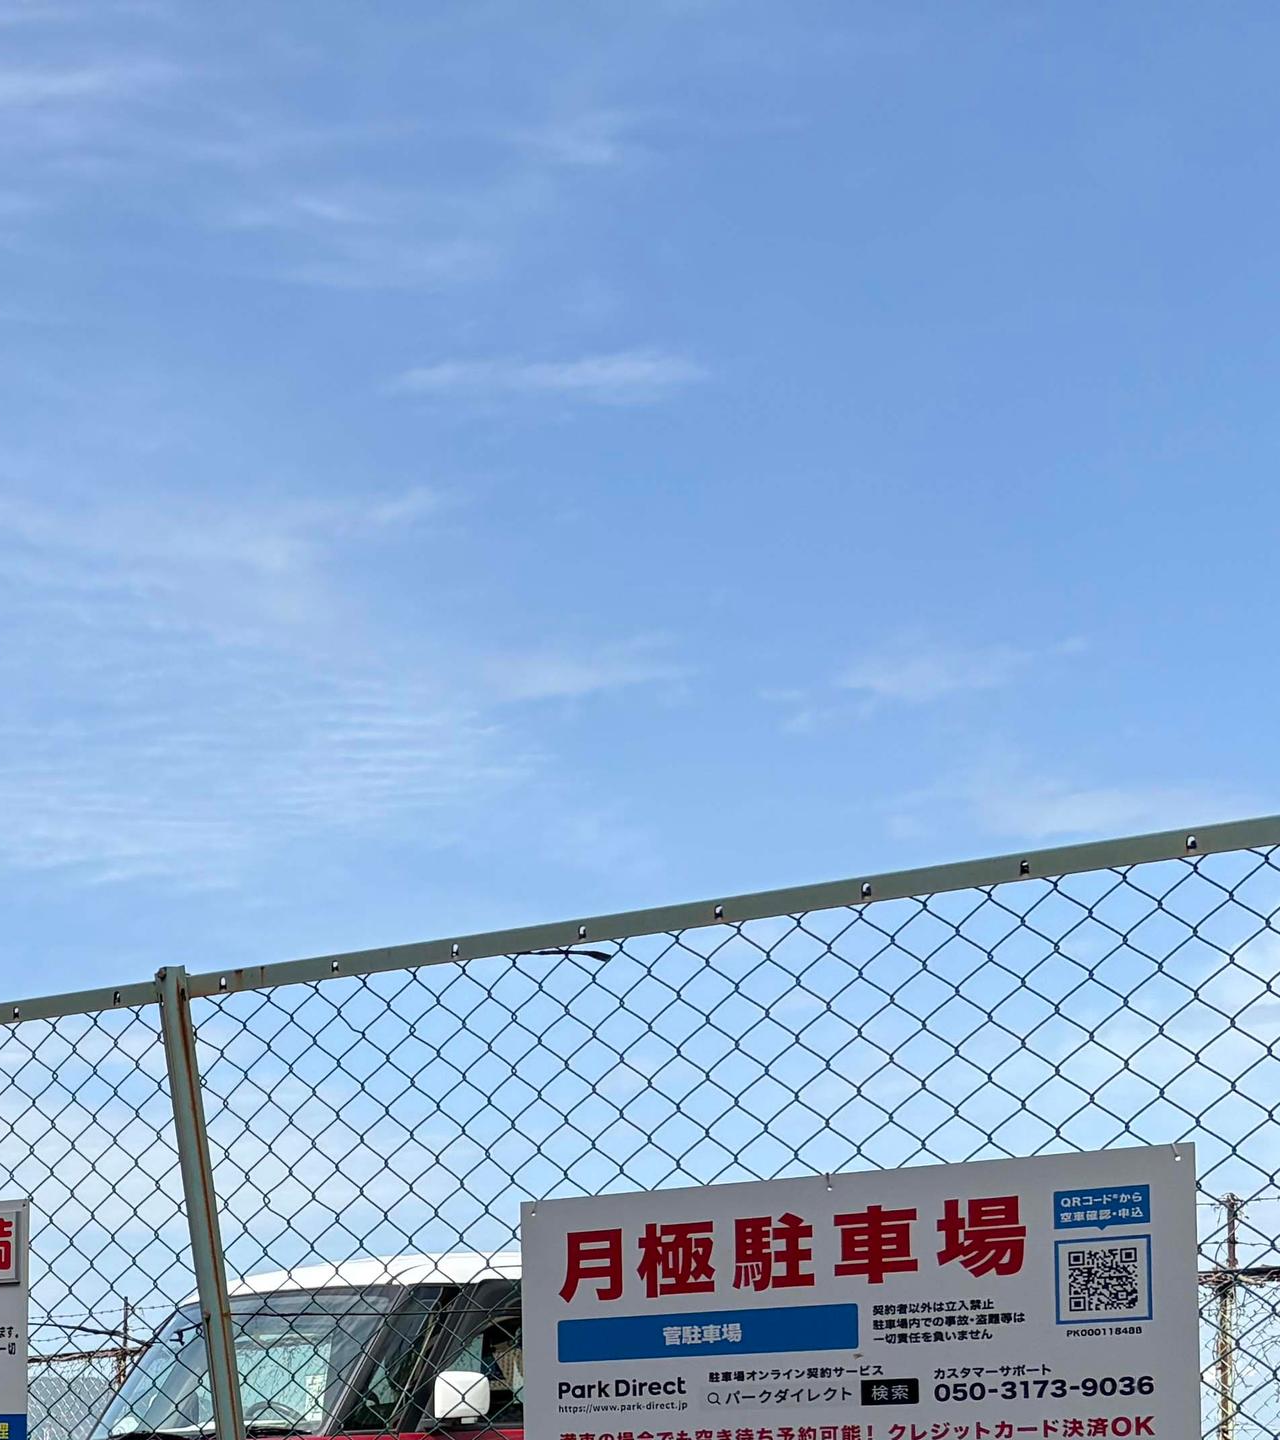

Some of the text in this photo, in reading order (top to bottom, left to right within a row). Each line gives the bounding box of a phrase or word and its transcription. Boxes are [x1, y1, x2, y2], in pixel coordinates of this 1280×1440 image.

[559, 1196, 1027, 1303] 月極駐車場
[708, 1365, 884, 1383] 駐車場オンライン契約サービス
[933, 1364, 1052, 1380] カスタマーサポート
[558, 1376, 686, 1400] Park Direct
[725, 1386, 853, 1405] パークダイレクト
[872, 1384, 910, 1402] 検索
[934, 1376, 1154, 1402] 050-3173-9036
[558, 1400, 688, 1414] https://www.park-direct.jp
